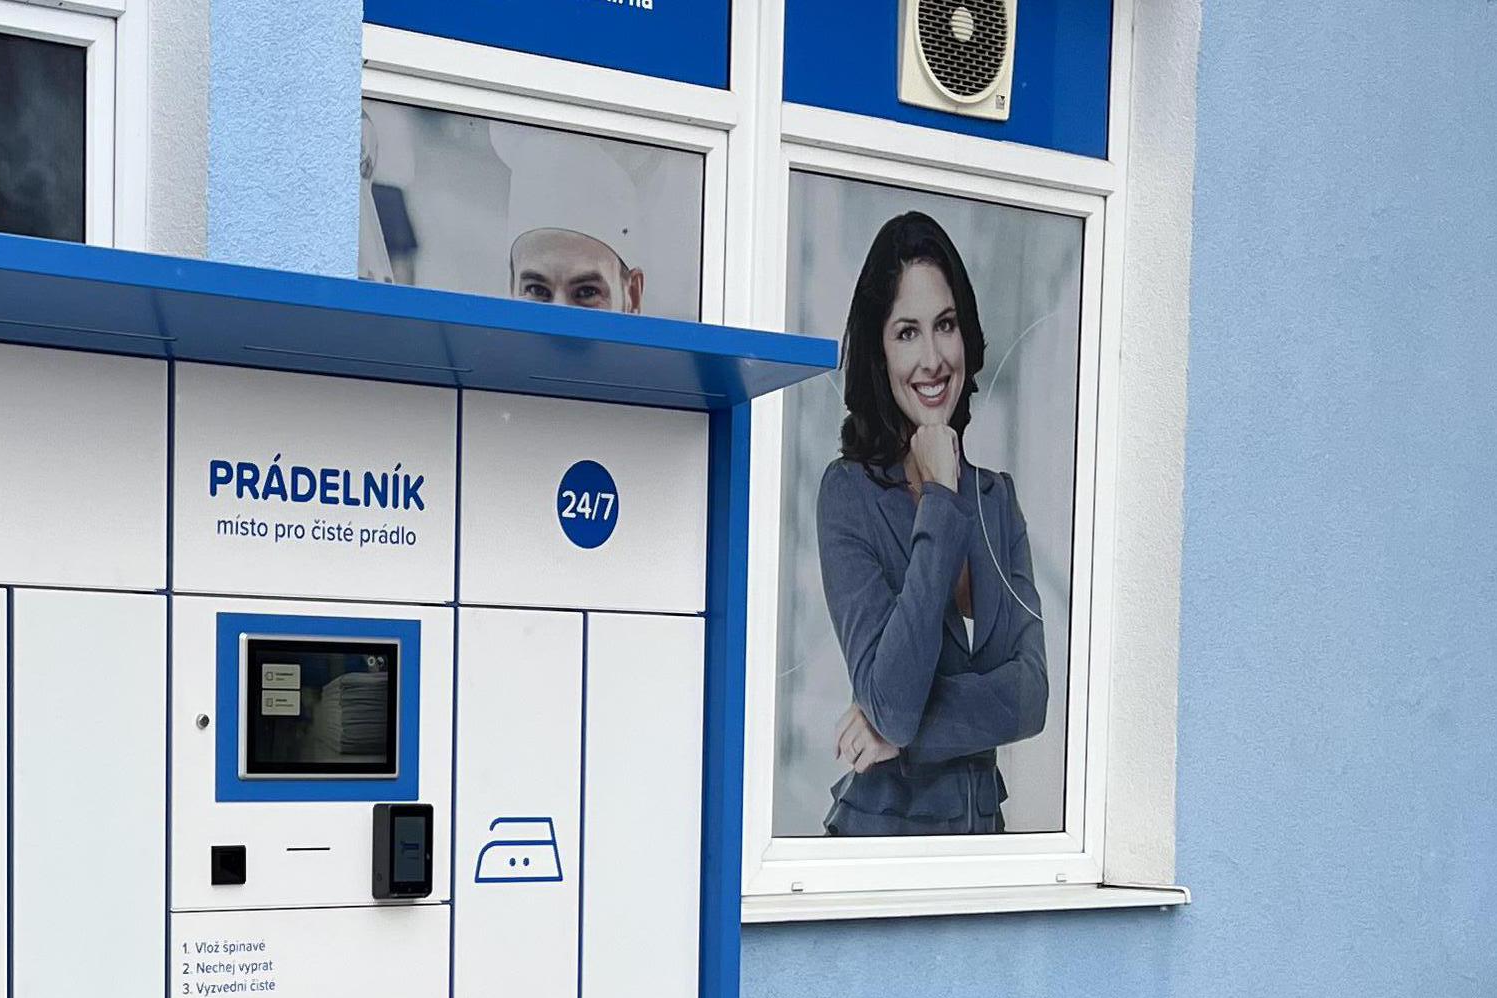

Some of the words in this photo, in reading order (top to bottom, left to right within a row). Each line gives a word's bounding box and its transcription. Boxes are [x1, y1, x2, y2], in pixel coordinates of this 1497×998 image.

[210, 453, 424, 511] PRÁDELNÍK
[562, 490, 615, 520] 24/7
[217, 514, 268, 536] místo
[275, 523, 305, 542] pro
[311, 519, 353, 541] čisté
[360, 524, 416, 547] prádlo
[195, 941, 219, 953] Vlož
[183, 963, 192, 974] 2.
[196, 961, 235, 975] Nechej
[238, 960, 272, 974] vyprat
[183, 983, 193, 995] 3.
